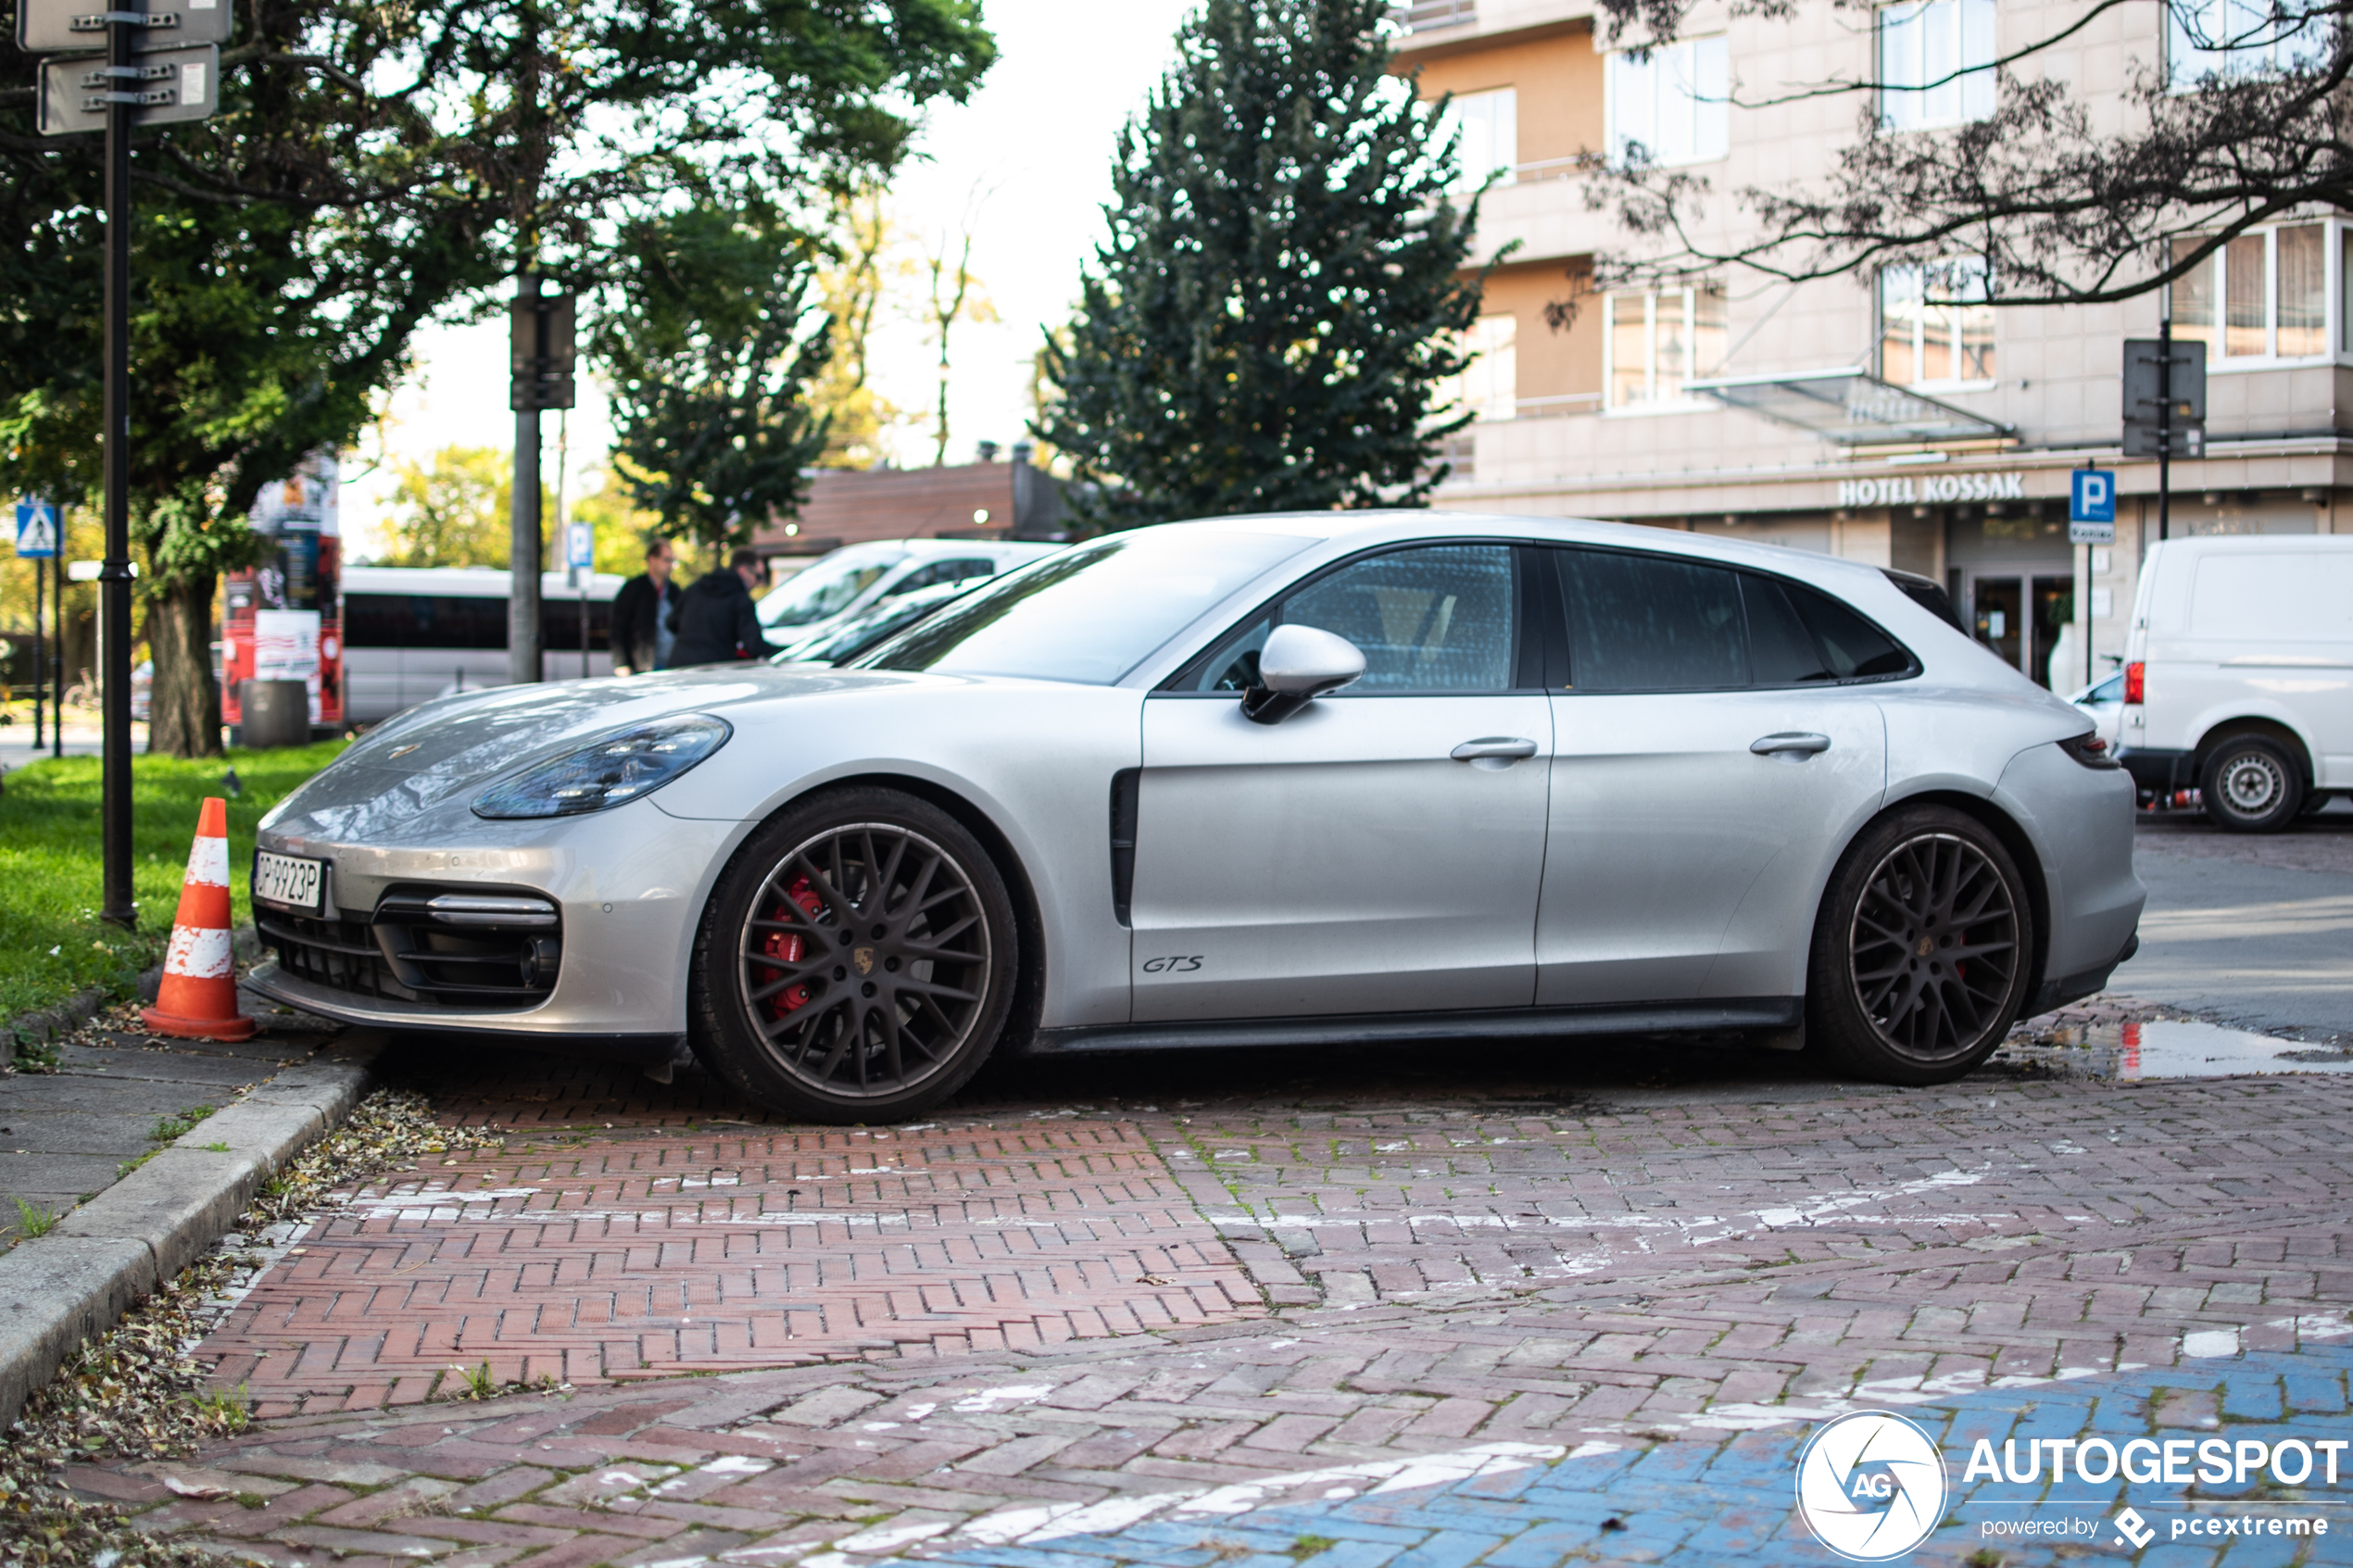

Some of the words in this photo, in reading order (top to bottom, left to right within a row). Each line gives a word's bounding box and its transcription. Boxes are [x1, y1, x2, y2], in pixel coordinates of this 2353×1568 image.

[1838, 480, 1916, 506] HOTEL
[1922, 473, 2025, 501] KOSSAK
[2082, 475, 2107, 516] P
[273, 859, 318, 903] 9923P
[1143, 956, 1204, 972] GTS
